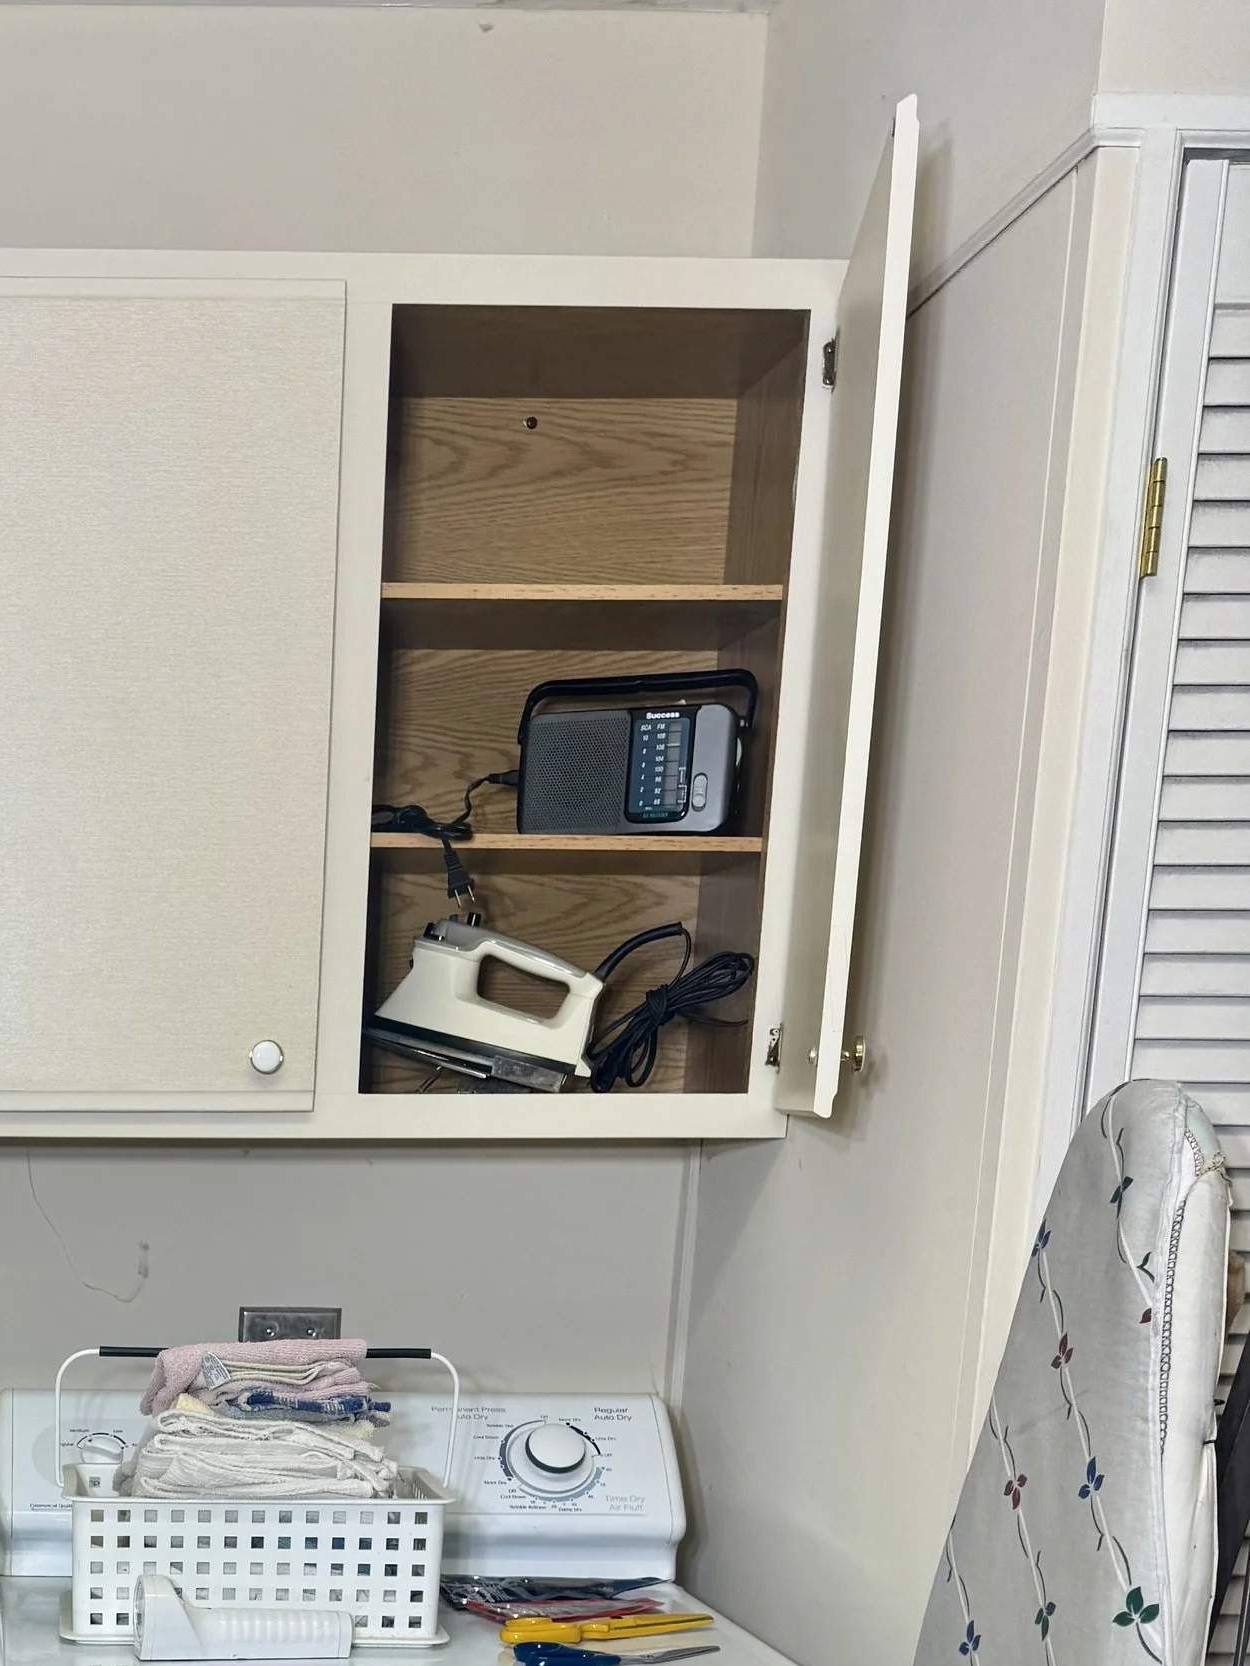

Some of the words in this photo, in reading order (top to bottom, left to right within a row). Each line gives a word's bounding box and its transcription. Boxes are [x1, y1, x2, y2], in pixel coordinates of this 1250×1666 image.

[646, 712, 680, 720] Success
[605, 1495, 625, 1503] Time
[626, 1495, 646, 1503] Dry
